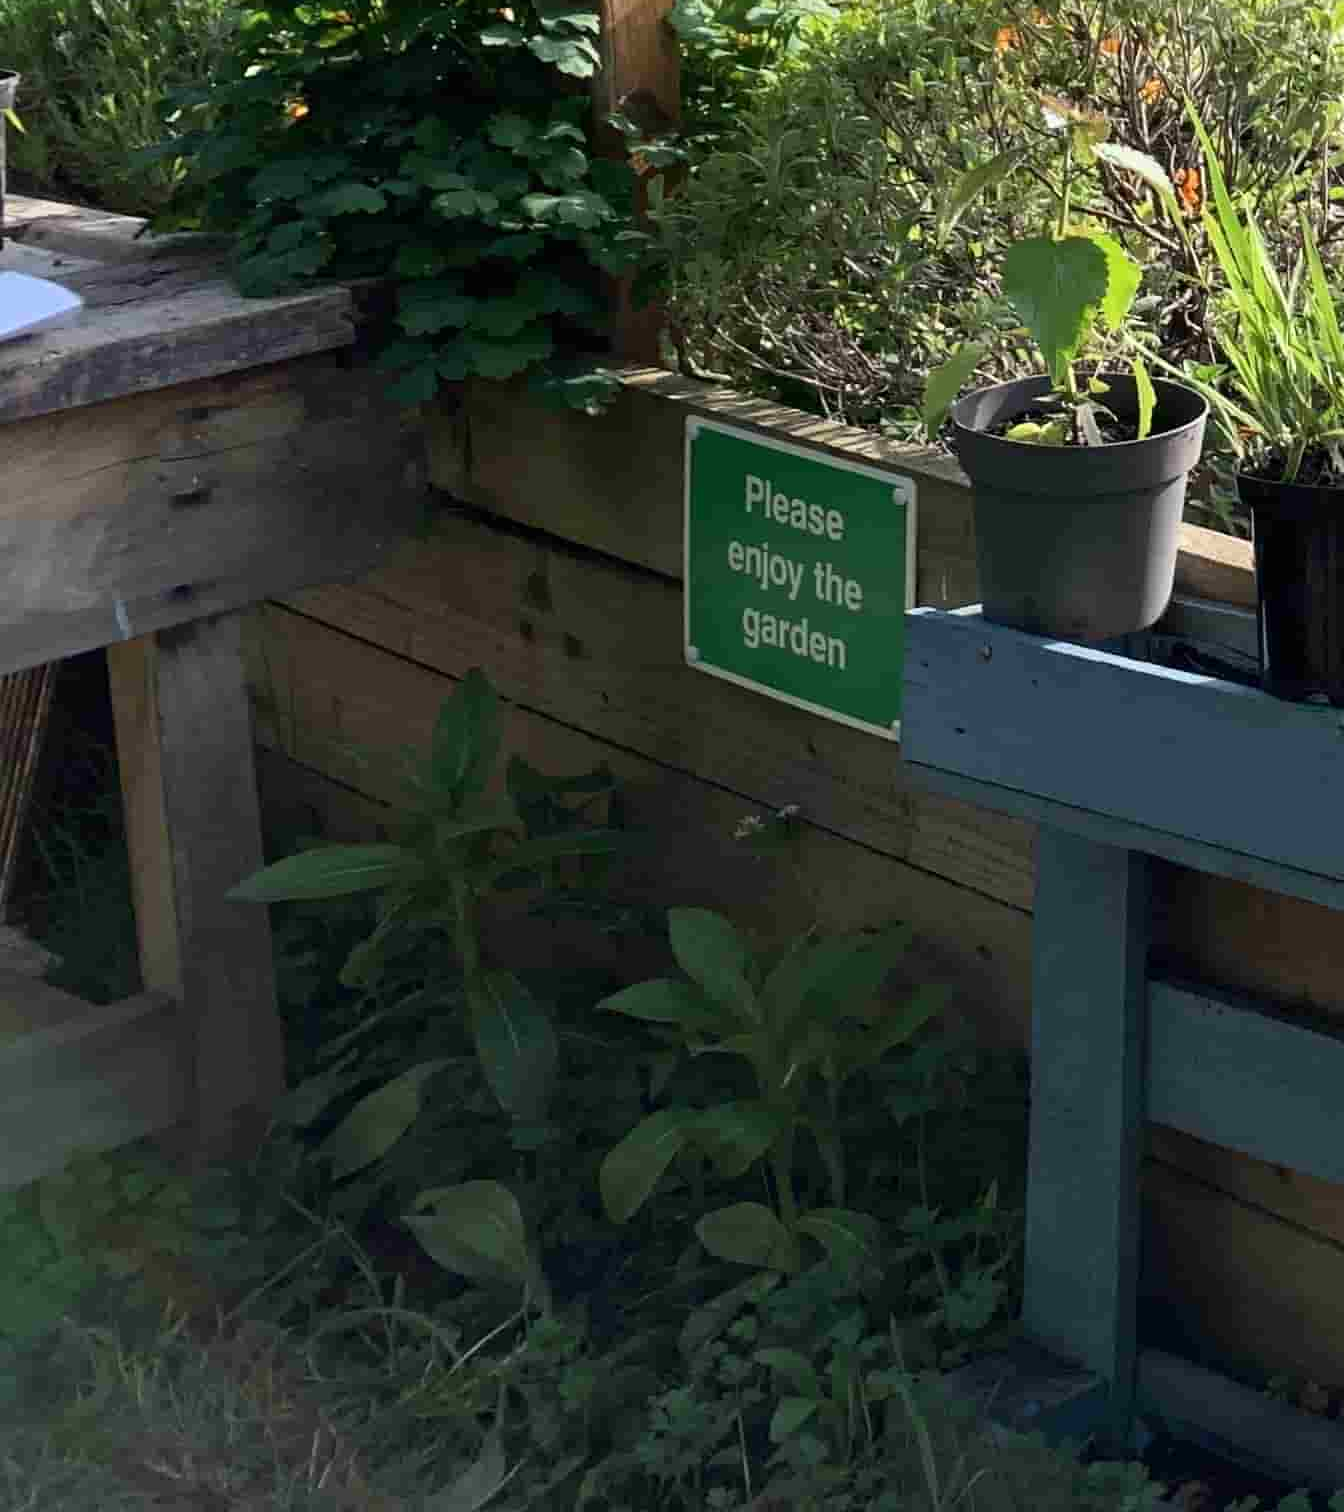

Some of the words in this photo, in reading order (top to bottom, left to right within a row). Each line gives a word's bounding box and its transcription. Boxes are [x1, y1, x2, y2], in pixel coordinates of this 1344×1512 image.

[745, 473, 845, 540] Please
[728, 540, 804, 601] enjoy
[813, 560, 864, 611] the
[742, 606, 847, 670] garden
